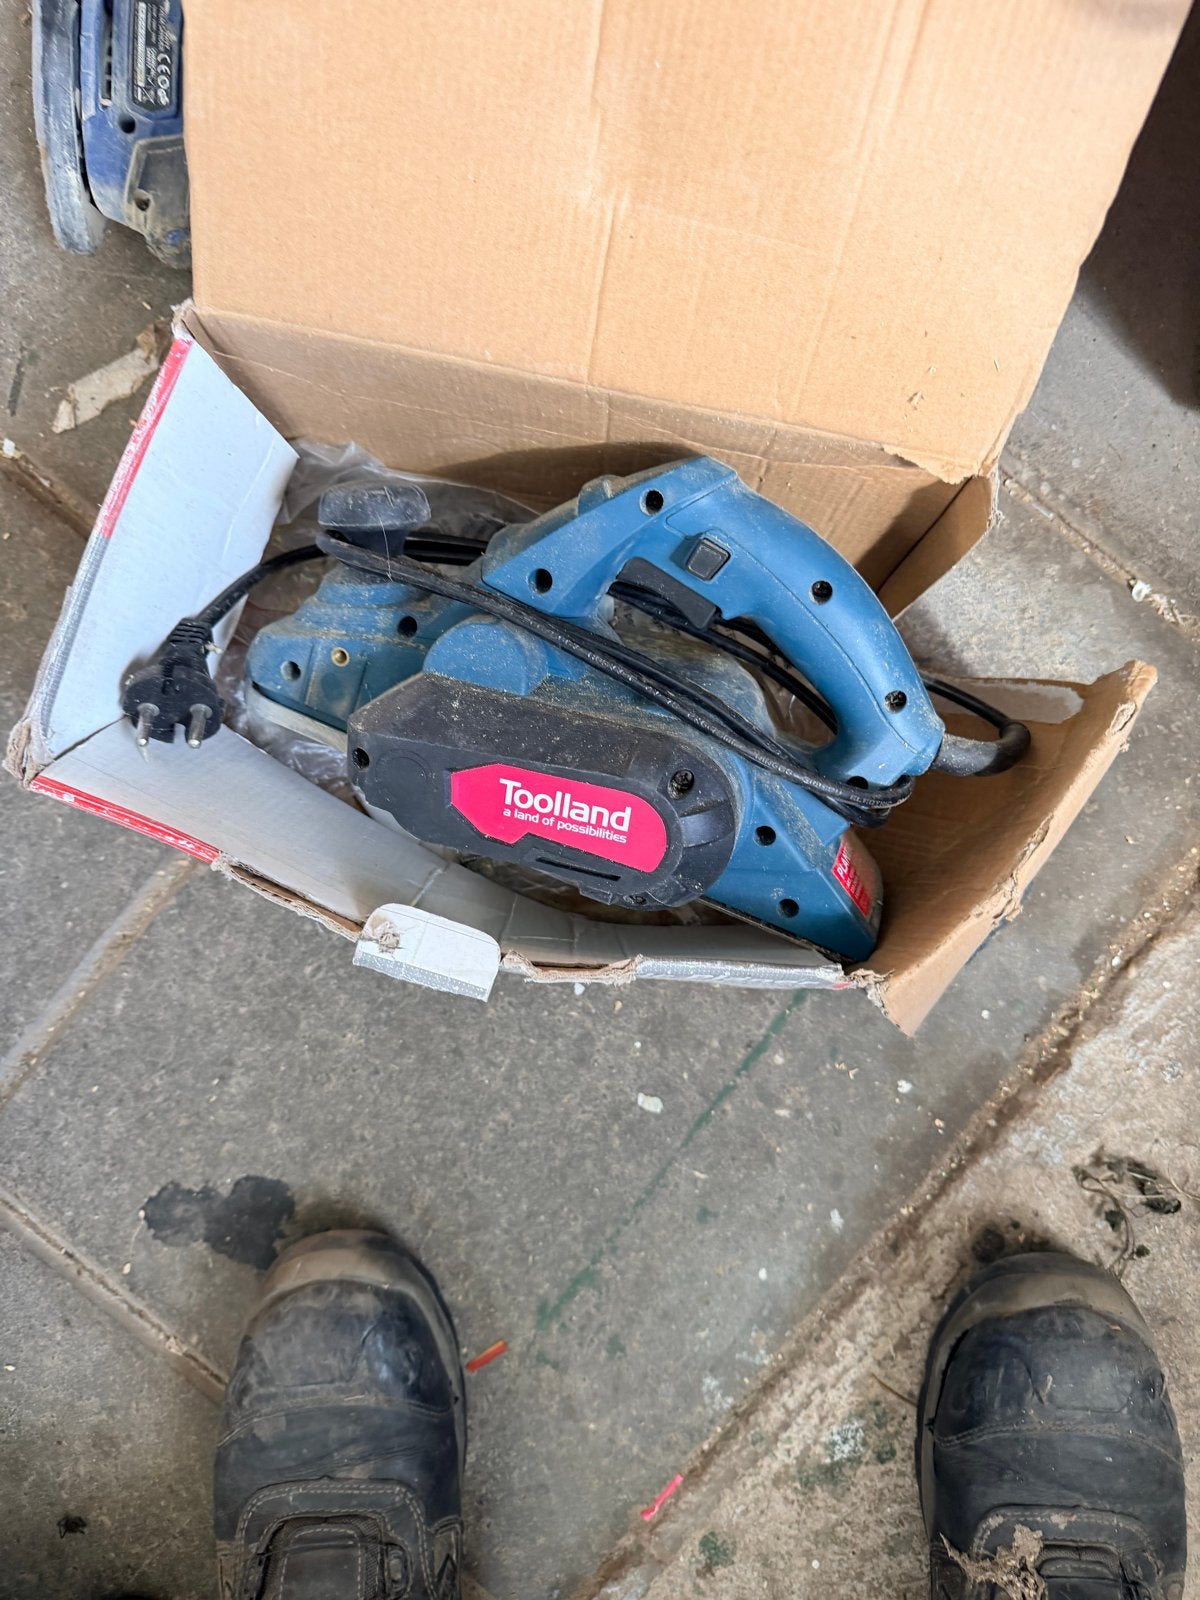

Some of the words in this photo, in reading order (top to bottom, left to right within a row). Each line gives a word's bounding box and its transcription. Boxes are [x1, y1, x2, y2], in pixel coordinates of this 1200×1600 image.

[500, 778, 631, 832] Toolland
[503, 808, 511, 817] a
[514, 808, 539, 824] land
[542, 816, 555, 827] of
[557, 820, 628, 844] possibilities
